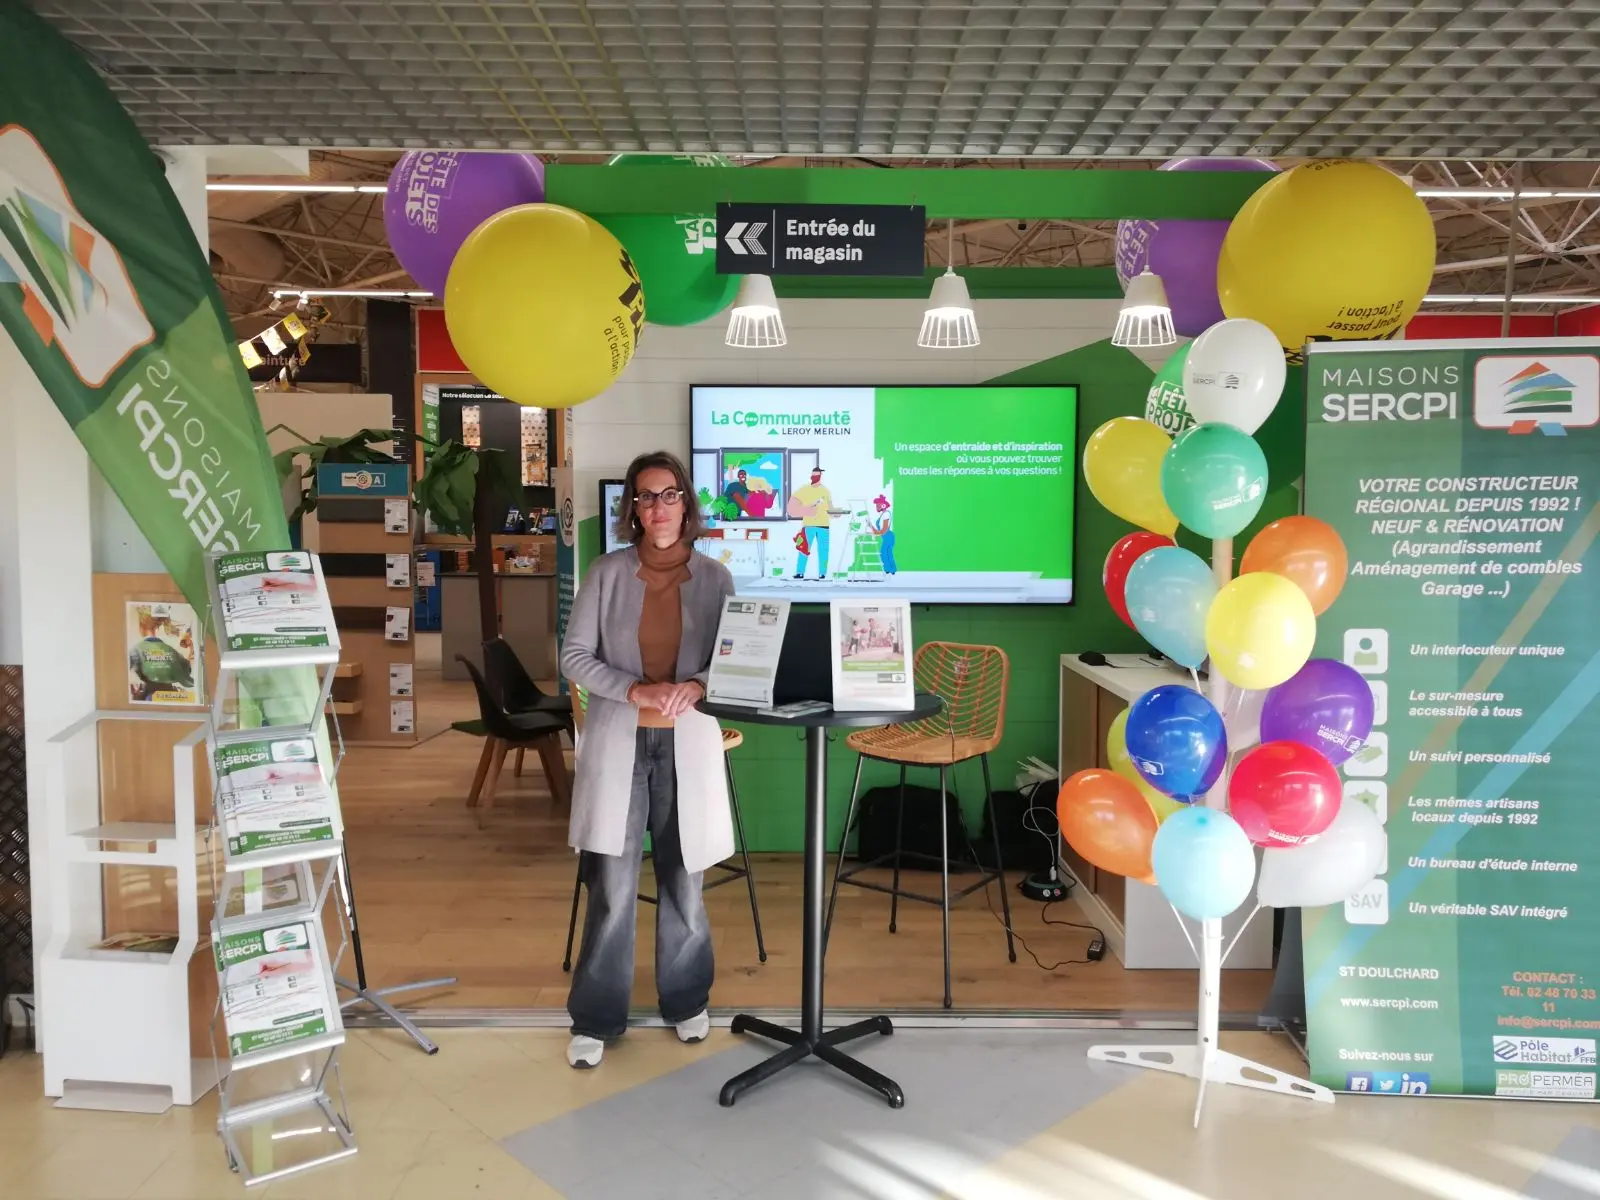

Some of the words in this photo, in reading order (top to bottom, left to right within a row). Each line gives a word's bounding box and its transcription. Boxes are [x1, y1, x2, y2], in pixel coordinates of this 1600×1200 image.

[425, 194, 440, 234] DES
[786, 218, 849, 237] Entrée
[852, 219, 876, 237] du
[786, 244, 863, 264] magasin
[1326, 320, 1372, 332] passer
[1322, 366, 1460, 386] MAISONS
[1160, 386, 1186, 413] FÊT
[1321, 392, 1457, 422] SERCPI
[711, 410, 730, 425] La
[814, 427, 851, 435] MERLIN
[894, 442, 908, 451] Un
[908, 443, 941, 453] espace
[943, 442, 991, 451] d'entraide
[992, 442, 1003, 451] et
[1004, 442, 1063, 453] d'inspiration
[956, 455, 968, 463] où
[993, 456, 1026, 465] pouvez
[1027, 455, 1062, 463] trouver
[898, 467, 928, 475] toutes
[929, 467, 942, 475] les
[944, 466, 986, 477] réponses
[987, 466, 993, 475] à
[995, 467, 1011, 475] vos
[1013, 467, 1057, 477] questions
[373, 475, 381, 484] A
[1359, 478, 1421, 493] VOTRE
[1425, 476, 1579, 492] CONSTRUCTEUR
[1355, 496, 1450, 514] RÉGIONAL
[1455, 497, 1523, 513] DEPUIS
[1528, 497, 1570, 513] 1992
[1573, 496, 1581, 511] !
[1371, 520, 1423, 535] NEUF
[1426, 519, 1439, 534] &
[1443, 516, 1564, 534] RÉNOVATION
[1392, 539, 1542, 558] (Agrandissement
[1351, 560, 1477, 578] Aménagement
[1480, 560, 1505, 575] de
[1507, 560, 1582, 575] combles
[1421, 581, 1484, 599] Garage
[1488, 581, 1511, 599] ...)
[1410, 644, 1428, 656] Un
[1431, 644, 1516, 656] interlocuteur
[1519, 645, 1565, 658] unique
[1409, 690, 1425, 701] Le
[1428, 691, 1504, 702] sur-mesure
[1408, 705, 1478, 718] accessible
[1480, 705, 1490, 718] à
[1493, 706, 1523, 718] tous
[1409, 750, 1428, 762] Un
[1431, 750, 1462, 763] suivi
[1464, 750, 1551, 767] personnalisé
[1408, 796, 1432, 808] Les
[1435, 795, 1482, 809] mêmes
[1485, 797, 1540, 810] artisans
[1411, 811, 1455, 824] locaux
[1458, 811, 1504, 826] depuis
[1508, 814, 1539, 825] 1992
[1408, 857, 1427, 868] Un
[1430, 857, 1475, 869] bureau
[1479, 858, 1528, 871] d'étude
[1531, 860, 1578, 872] interne
[1350, 894, 1383, 909] SAV
[1409, 902, 1428, 914] Un
[1430, 903, 1487, 916] véritable
[1490, 904, 1518, 917] SAV
[1521, 905, 1568, 920] intégré
[219, 935, 262, 951] AISONS
[1339, 966, 1356, 977] ST
[1359, 967, 1439, 979] DOULCHARD
[1512, 971, 1576, 984] CONTACT
[1502, 986, 1523, 997] Tél.
[1527, 987, 1542, 998] 02
[1544, 987, 1560, 998] 48
[1563, 988, 1577, 998] 70
[1581, 989, 1596, 999] 33
[1340, 997, 1439, 1010] www.sercpi.com
[1542, 1002, 1555, 1012] 11
[1497, 1015, 1600, 1029] info@sercpi.com
[1520, 1039, 1549, 1051] Pôle
[1339, 1049, 1411, 1061] Suivez-nous
[1414, 1052, 1434, 1062] sur
[1520, 1051, 1571, 1063] Habitat
[1498, 1073, 1529, 1085] PRO
[1533, 1071, 1592, 1086] PERMÉA
